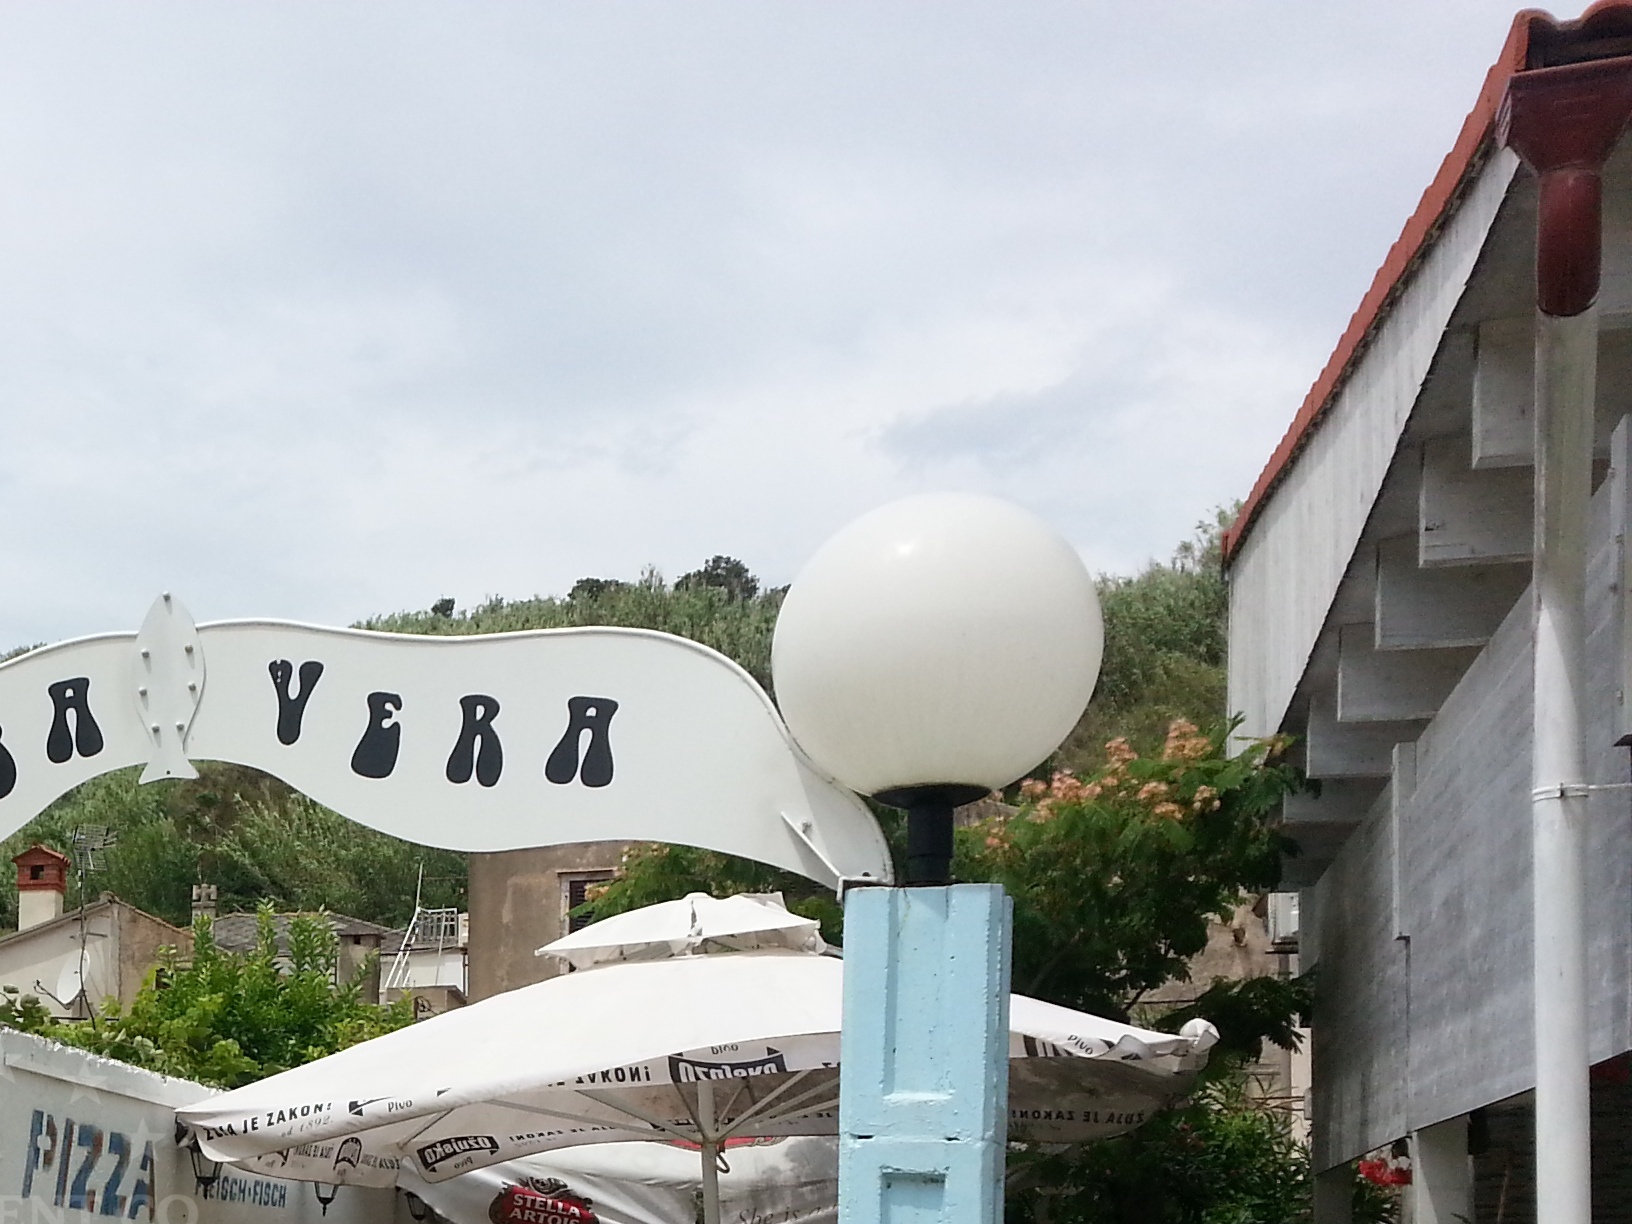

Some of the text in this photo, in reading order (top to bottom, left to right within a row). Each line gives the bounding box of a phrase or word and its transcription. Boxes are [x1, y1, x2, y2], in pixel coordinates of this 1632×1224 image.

[267, 659, 619, 788] VERA
[242, 1116, 260, 1135] JE
[266, 1102, 333, 1128] ZAKON!
[21, 1109, 156, 1224] PIZZA
[513, 1193, 581, 1218] STELLA
